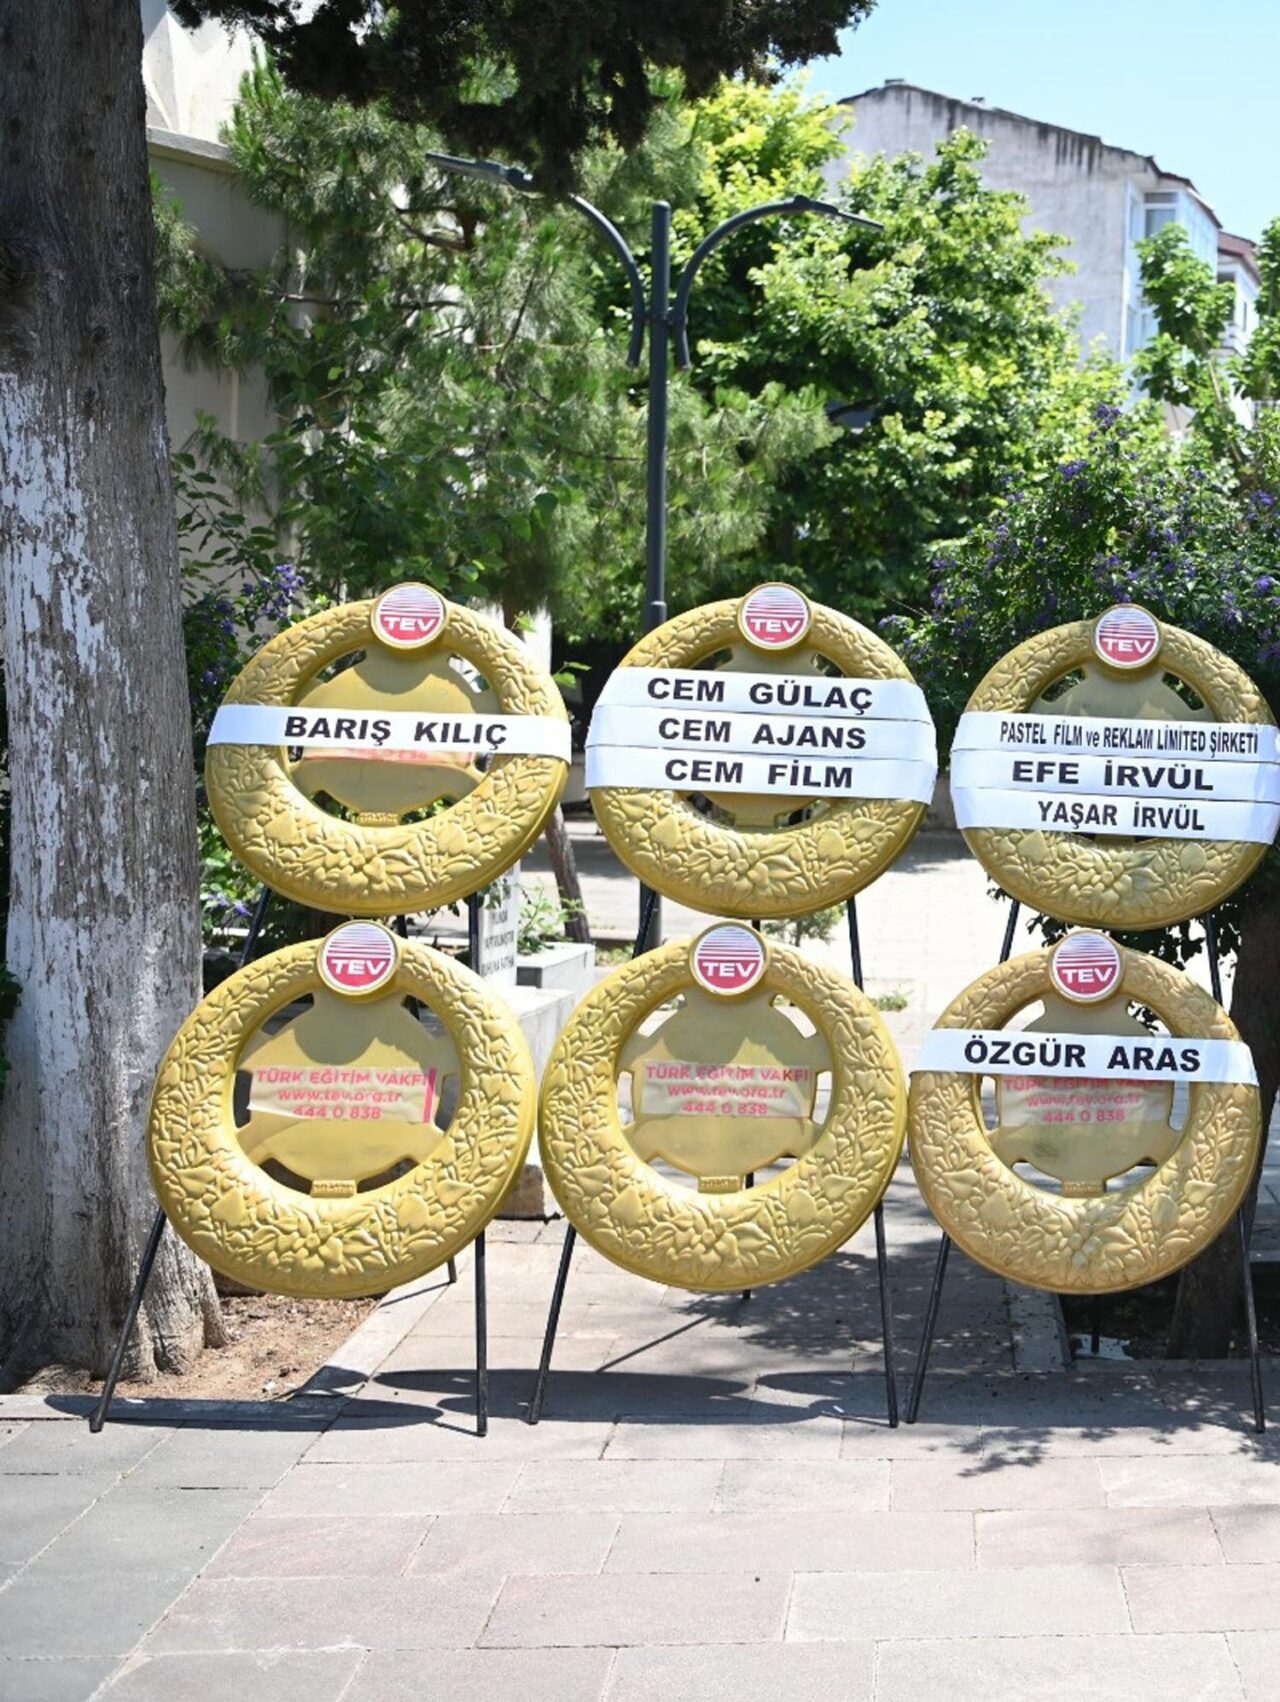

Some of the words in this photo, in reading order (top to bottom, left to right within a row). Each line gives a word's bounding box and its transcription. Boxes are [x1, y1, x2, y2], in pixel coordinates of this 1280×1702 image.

[383, 617, 436, 632] TEV
[750, 618, 801, 633] TEV
[1102, 638, 1152, 654] TEV
[647, 677, 726, 702] CEM
[748, 680, 873, 716] GÜLAÇ
[284, 715, 392, 746] BARIŞ
[413, 721, 508, 751] KILIÇ
[658, 717, 732, 743] CEM
[752, 723, 867, 750] AJANS
[999, 720, 1047, 745] PASTEL
[1054, 719, 1083, 747] FİLM
[1085, 733, 1100, 747] ve
[1103, 726, 1154, 751] REKLAM
[1157, 724, 1206, 752] LİMİTED
[1210, 726, 1259, 758] ŞİRKETİ
[664, 758, 744, 784] CEM
[767, 760, 853, 789] FİLM
[1011, 760, 1080, 784] EFE
[1103, 759, 1214, 791] İRVÜL
[1038, 800, 1118, 830] YAŞAR
[1132, 801, 1205, 832] İRVÜL
[331, 959, 388, 975] TEV
[702, 962, 757, 978] TEV
[1061, 968, 1113, 983] TEV
[963, 1034, 1087, 1068] ÖZGÜR
[1106, 1046, 1201, 1073] ARAS
[256, 1068, 304, 1084] TÜRK
[309, 1069, 370, 1085] EĞİTİM
[376, 1072, 428, 1087] VAKFI
[646, 1064, 691, 1080] TÜRK
[760, 1068, 809, 1082] VAKFI
[294, 1105, 327, 1118] 444
[332, 1107, 344, 1119] 0
[349, 1106, 382, 1120] 838
